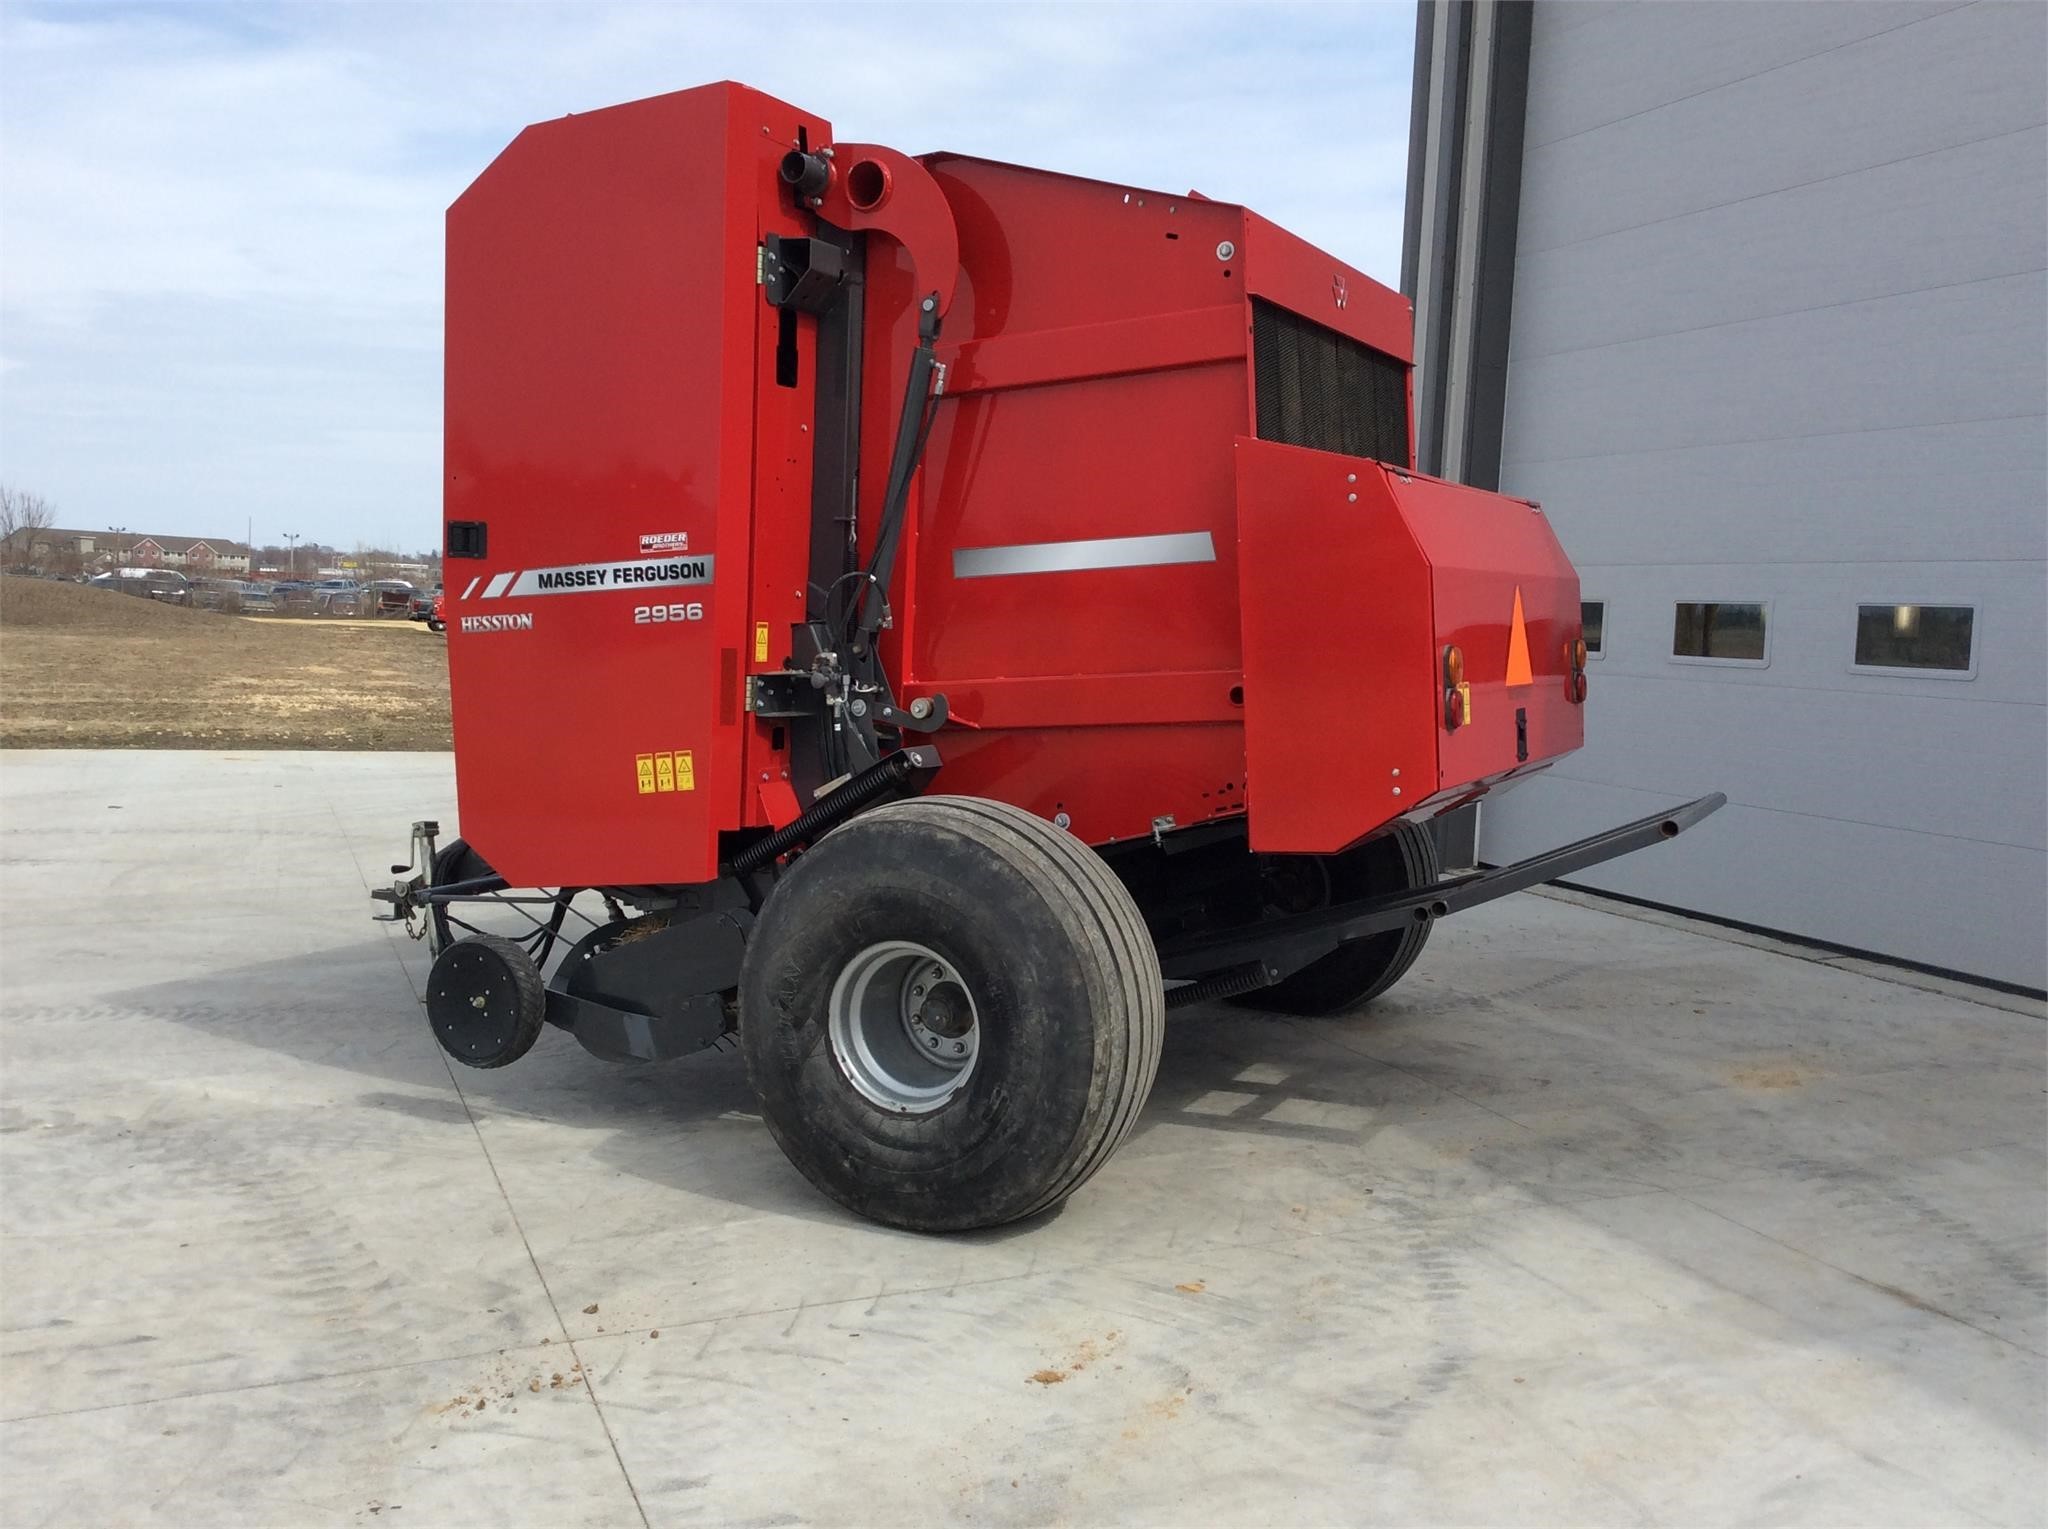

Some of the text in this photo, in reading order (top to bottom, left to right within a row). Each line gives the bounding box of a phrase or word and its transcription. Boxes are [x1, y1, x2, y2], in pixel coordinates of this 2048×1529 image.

[641, 533, 686, 545] ROEDER
[538, 562, 706, 589] MASSEY FERGUSON
[460, 612, 533, 633] HESSTON
[634, 603, 703, 624] 2956
